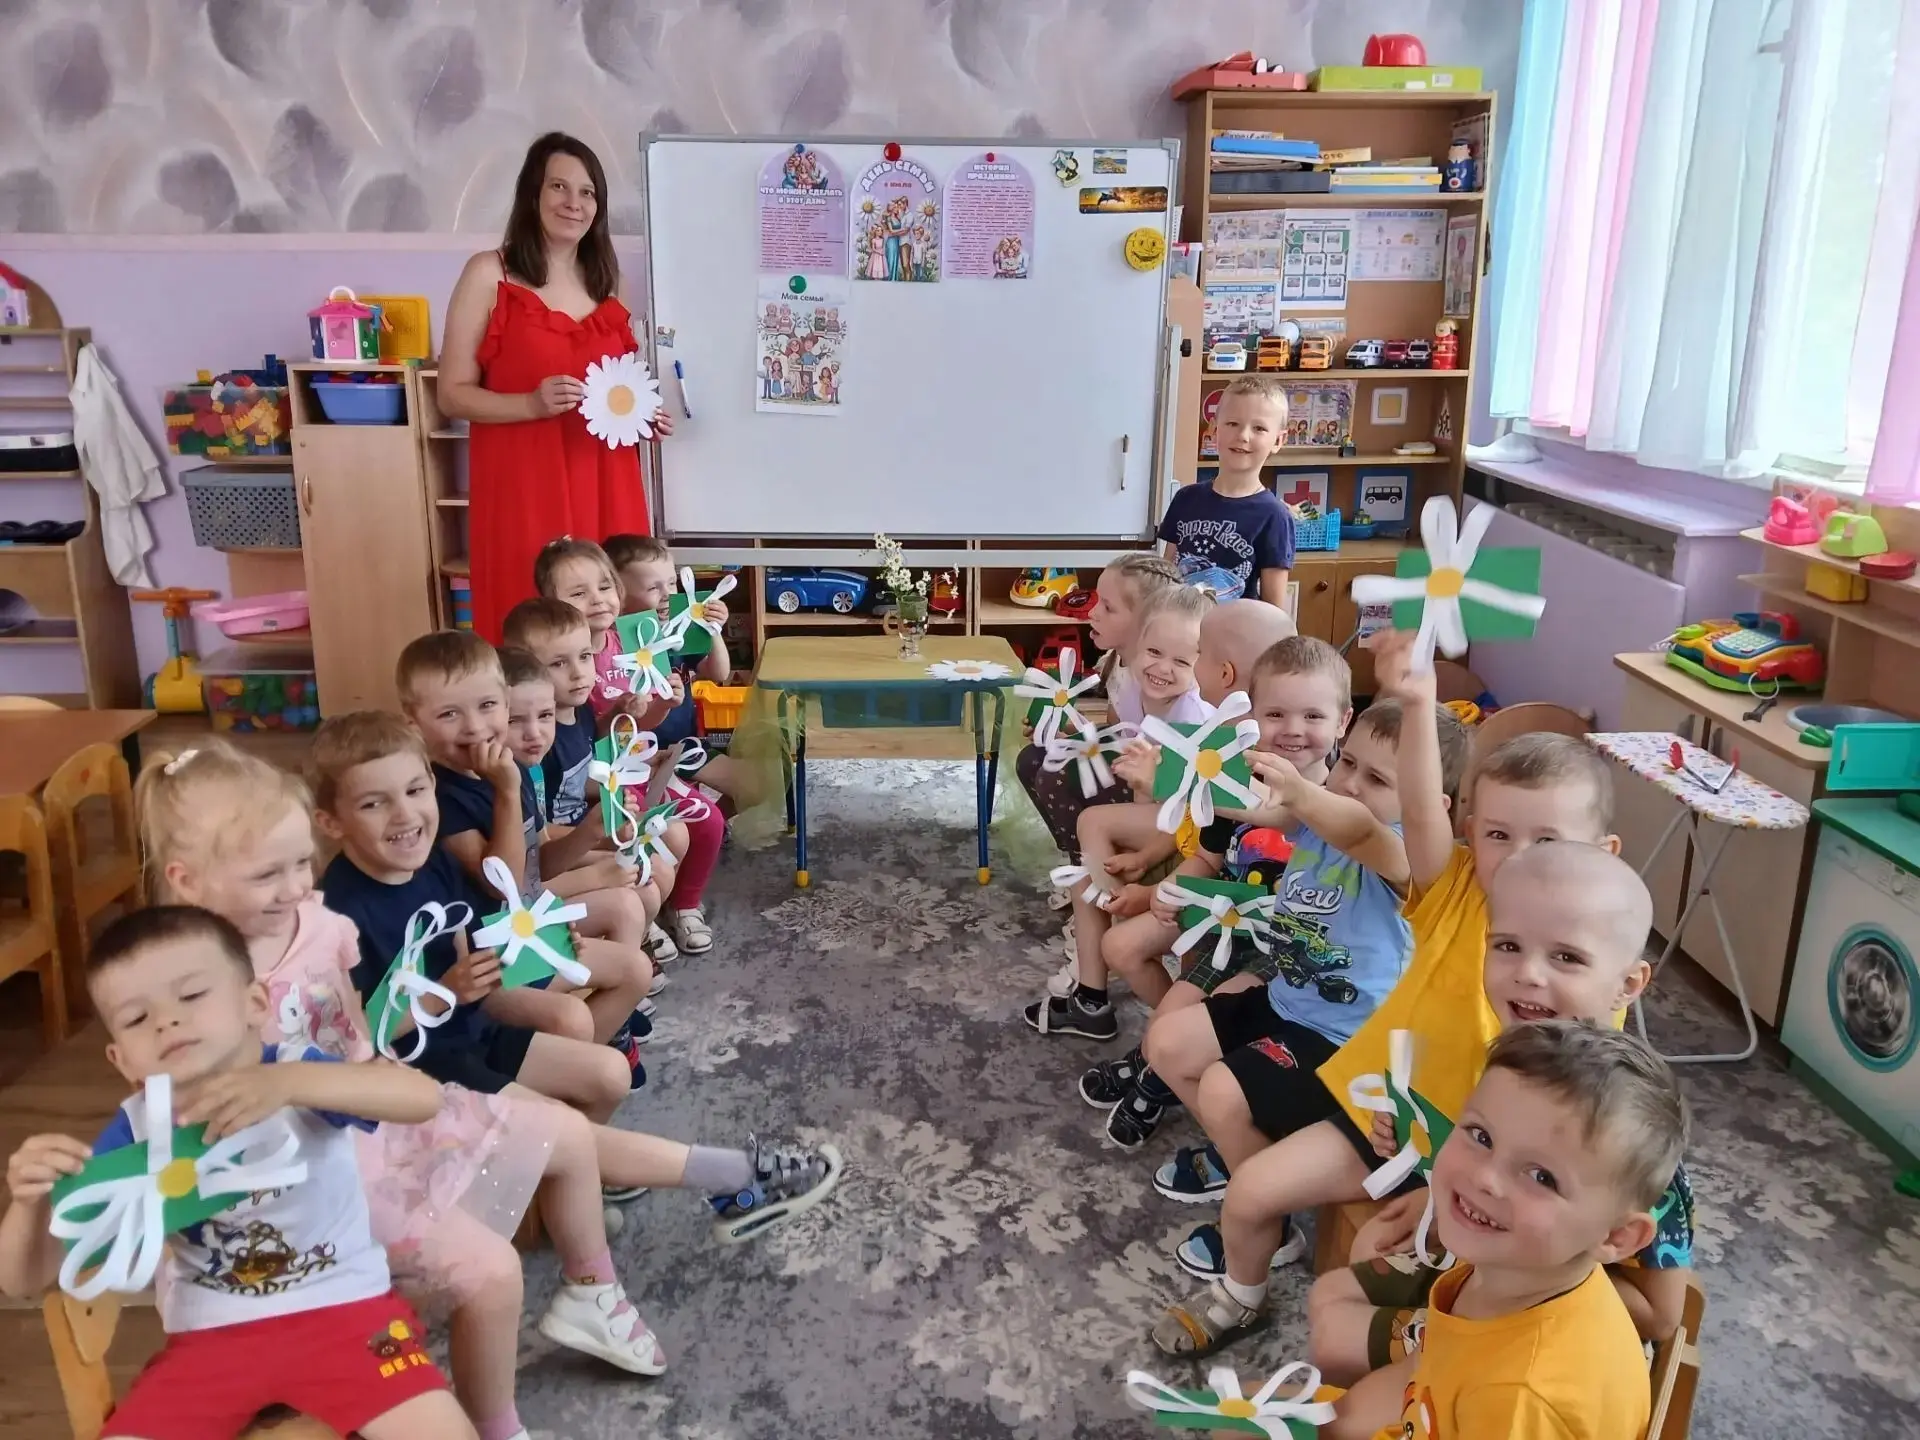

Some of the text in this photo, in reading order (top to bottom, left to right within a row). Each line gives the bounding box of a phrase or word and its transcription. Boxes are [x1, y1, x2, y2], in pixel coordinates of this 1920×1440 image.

[861, 160, 936, 193] ДЕНЬ СЕМЬИ
[760, 187, 843, 197] ЧТО МОЖНО СДЕЛАТЬ
[781, 292, 798, 300] Моя
